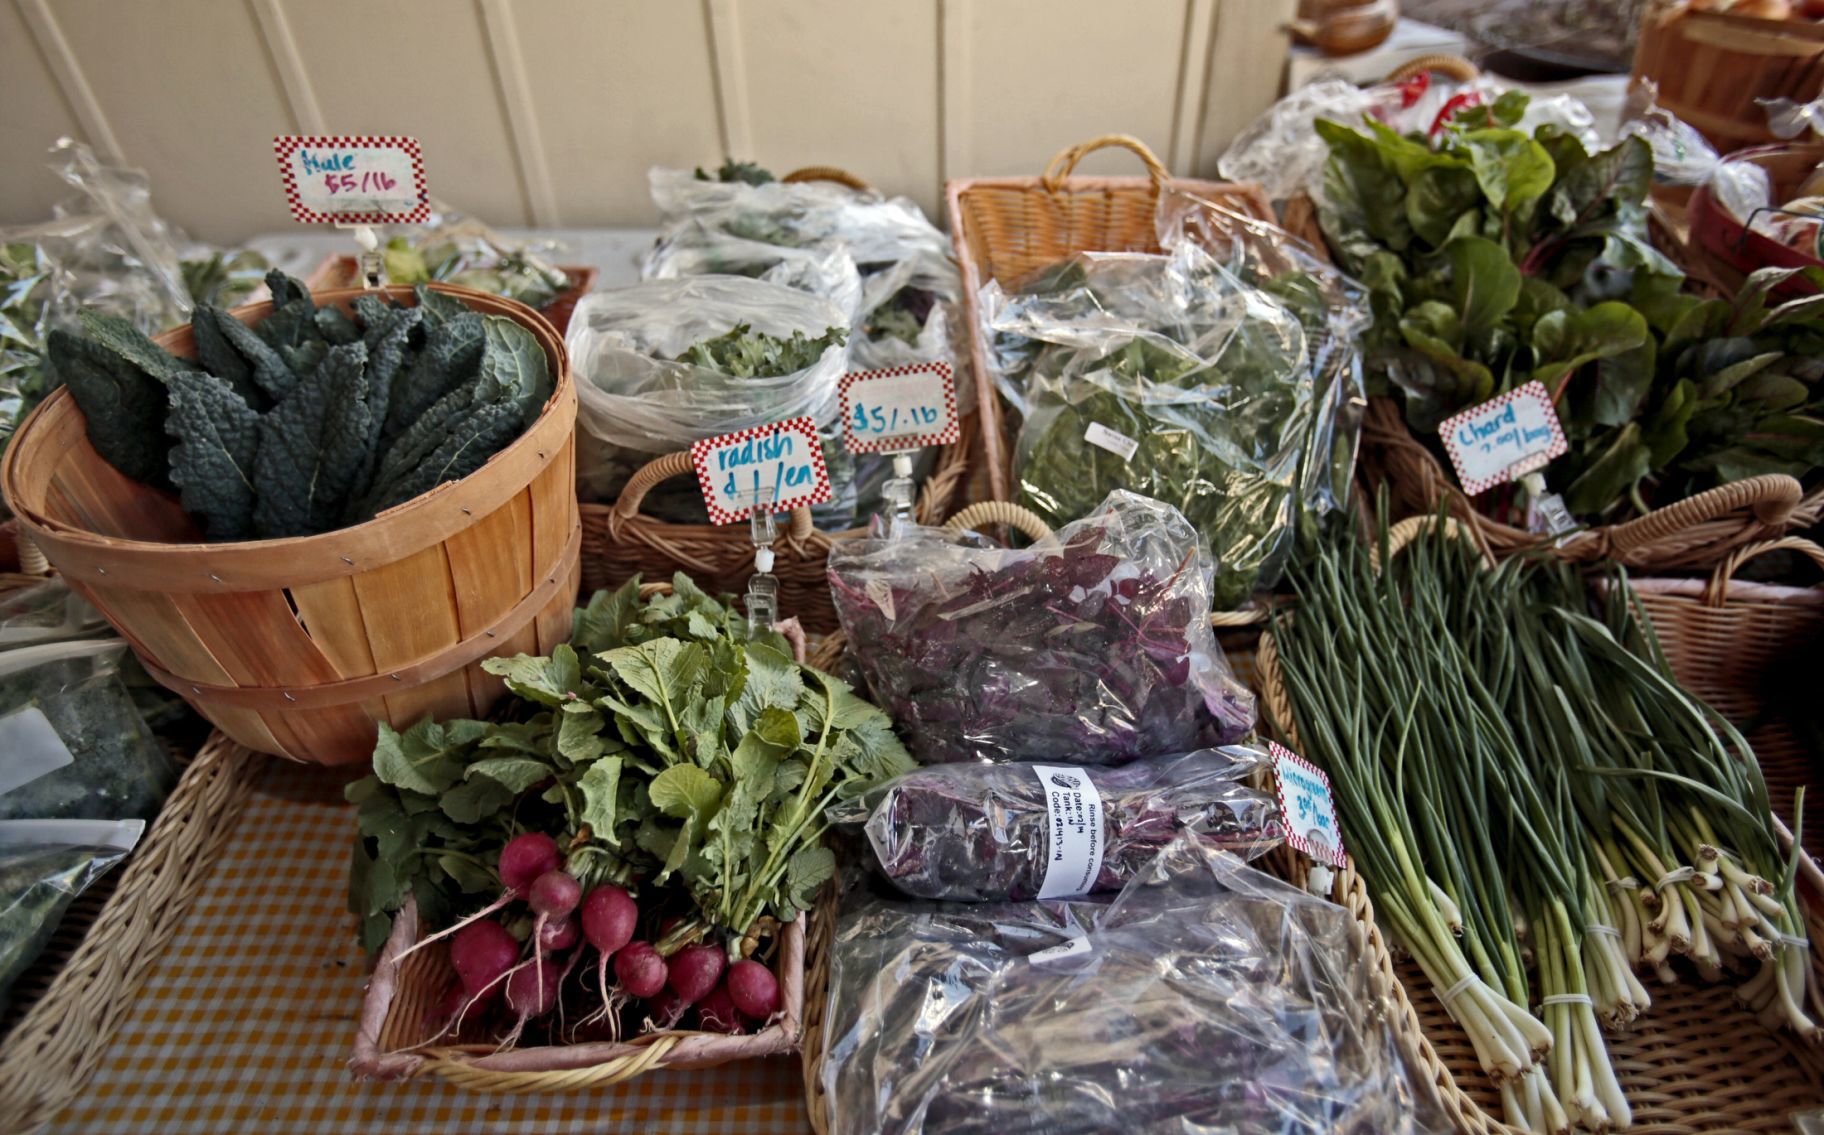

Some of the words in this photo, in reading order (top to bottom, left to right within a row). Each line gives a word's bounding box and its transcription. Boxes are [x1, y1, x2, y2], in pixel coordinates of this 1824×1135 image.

[1459, 402, 1516, 446] Chard
[718, 427, 793, 472] radish
[1088, 803, 1096, 828] Rinse
[1089, 828, 1097, 856] before
